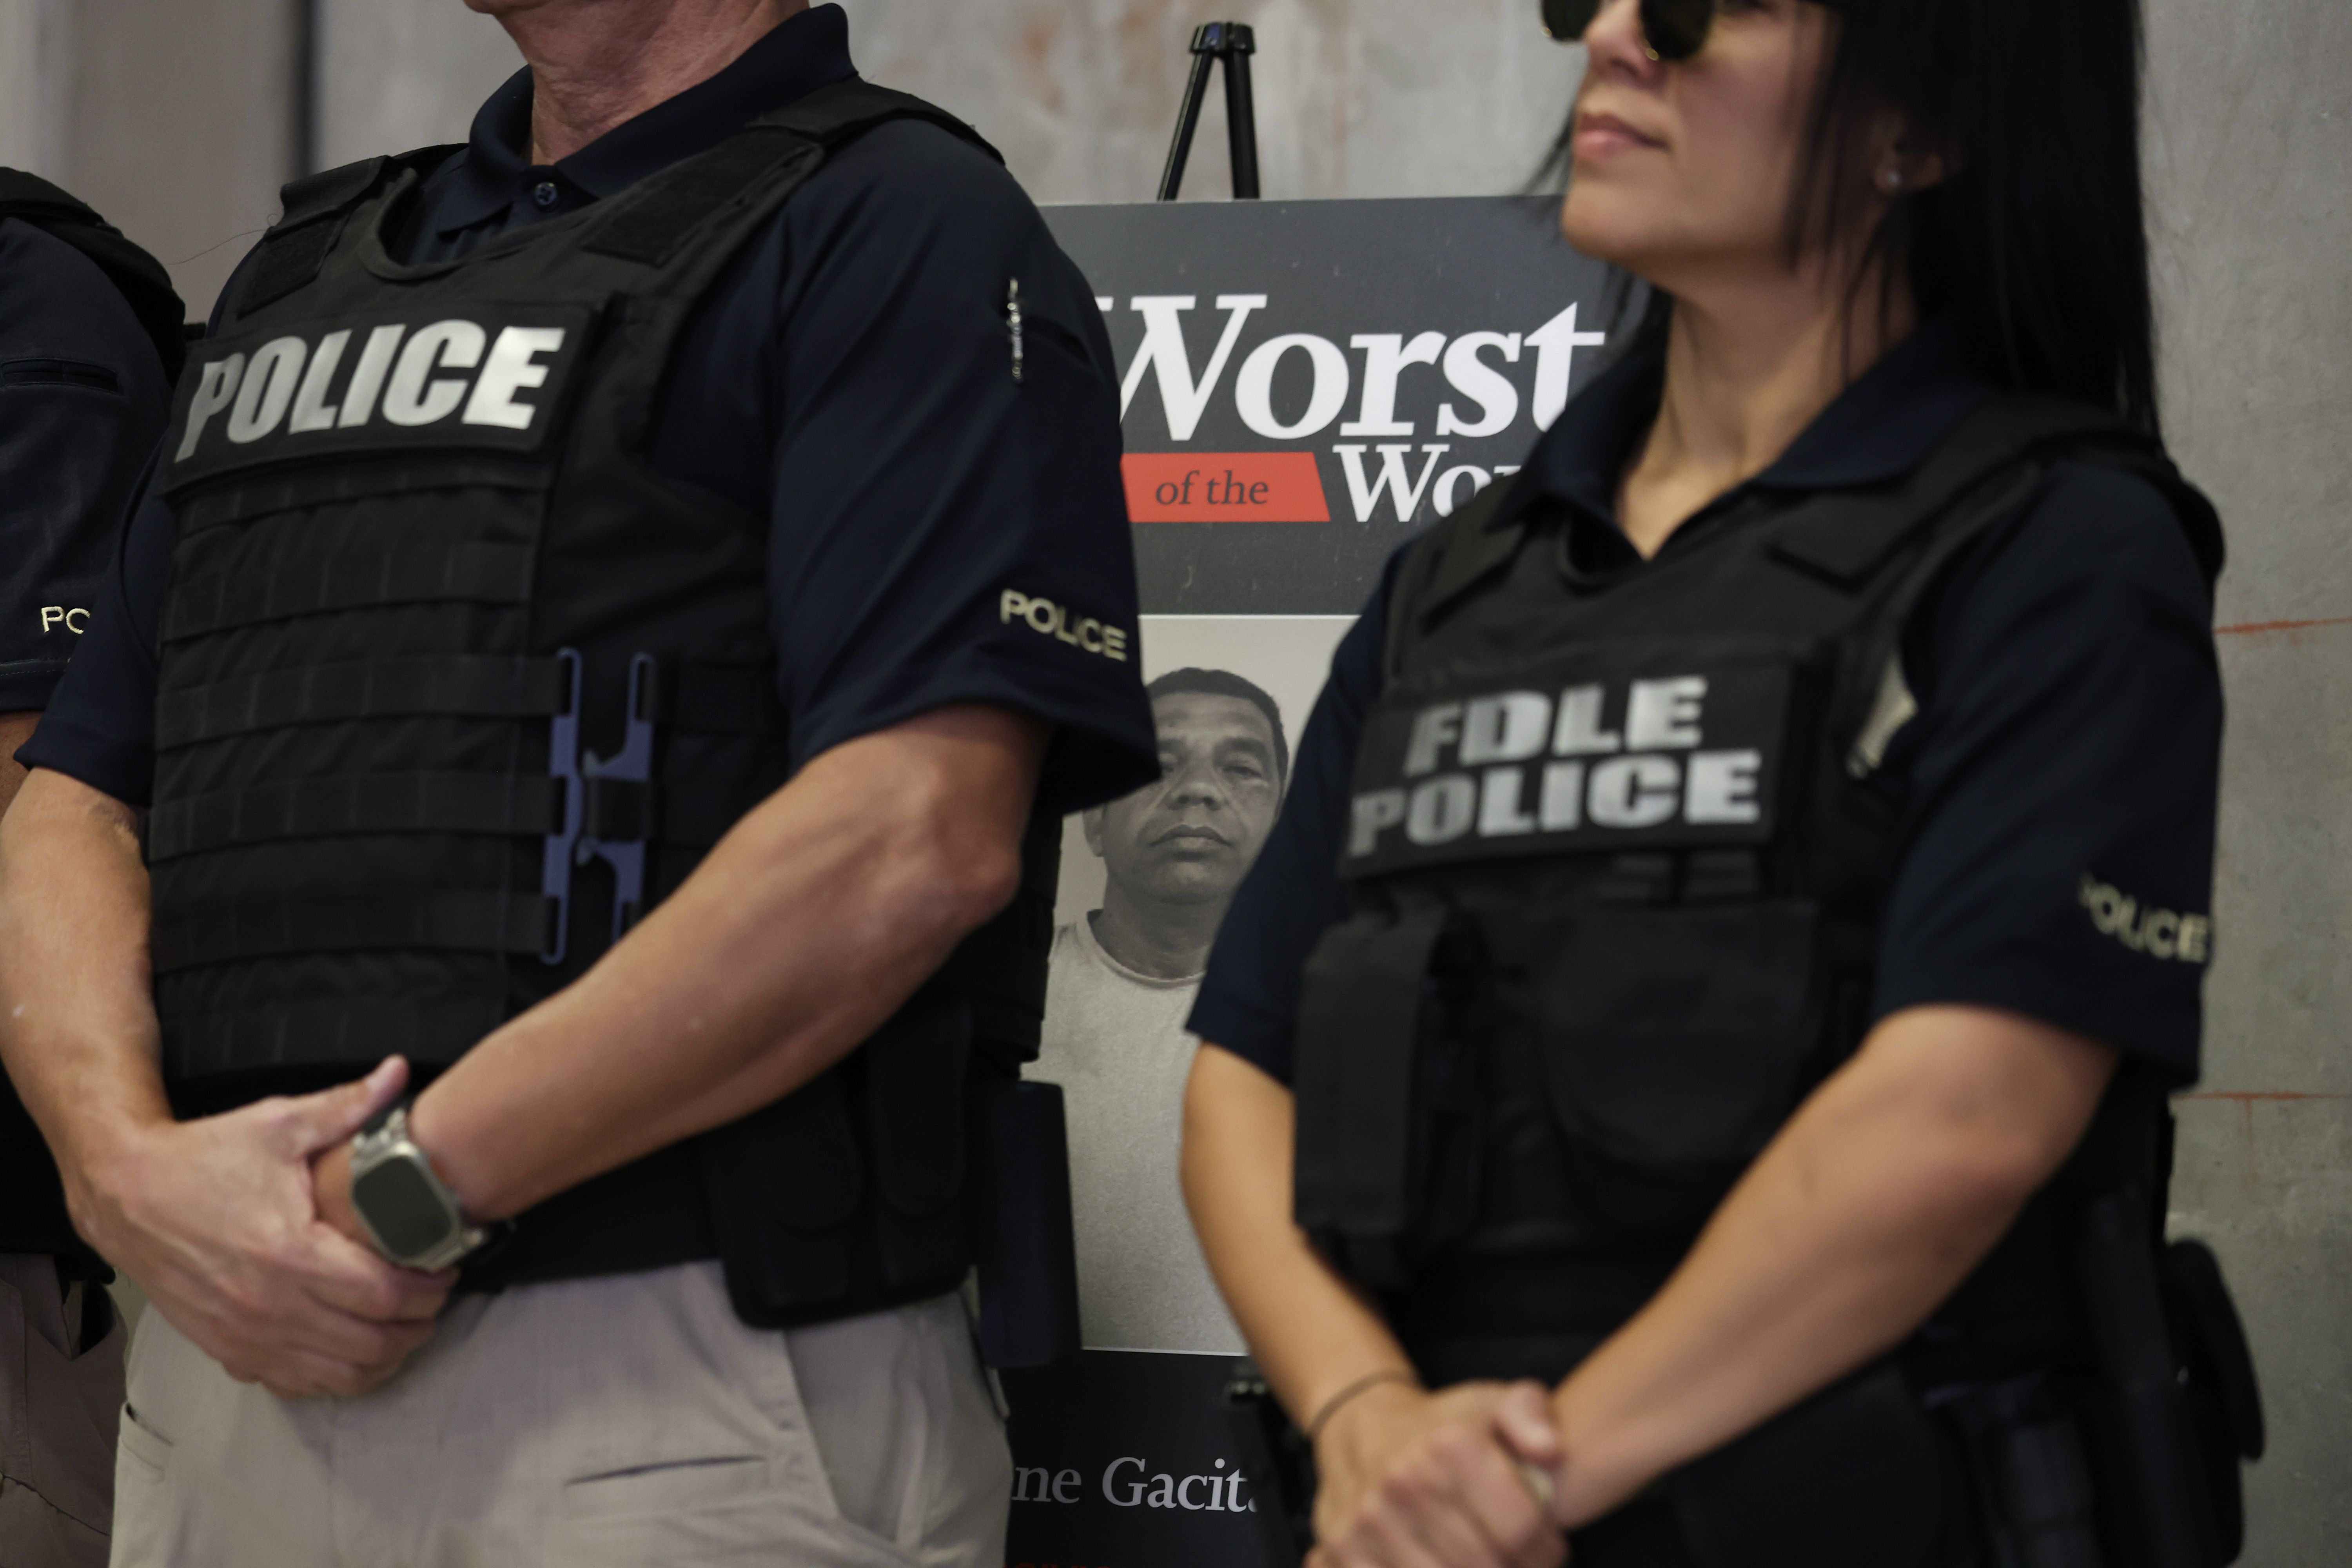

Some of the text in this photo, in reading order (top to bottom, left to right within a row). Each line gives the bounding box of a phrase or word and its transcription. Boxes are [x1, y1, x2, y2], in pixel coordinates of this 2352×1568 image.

[175, 319, 566, 463] POLICE
[1096, 295, 1605, 441] Worst
[1155, 444, 1521, 522] of the Wo
[1000, 588, 1128, 662] POLICE
[1404, 675, 1708, 778] FDLE
[1348, 748, 1762, 858] POLICE
